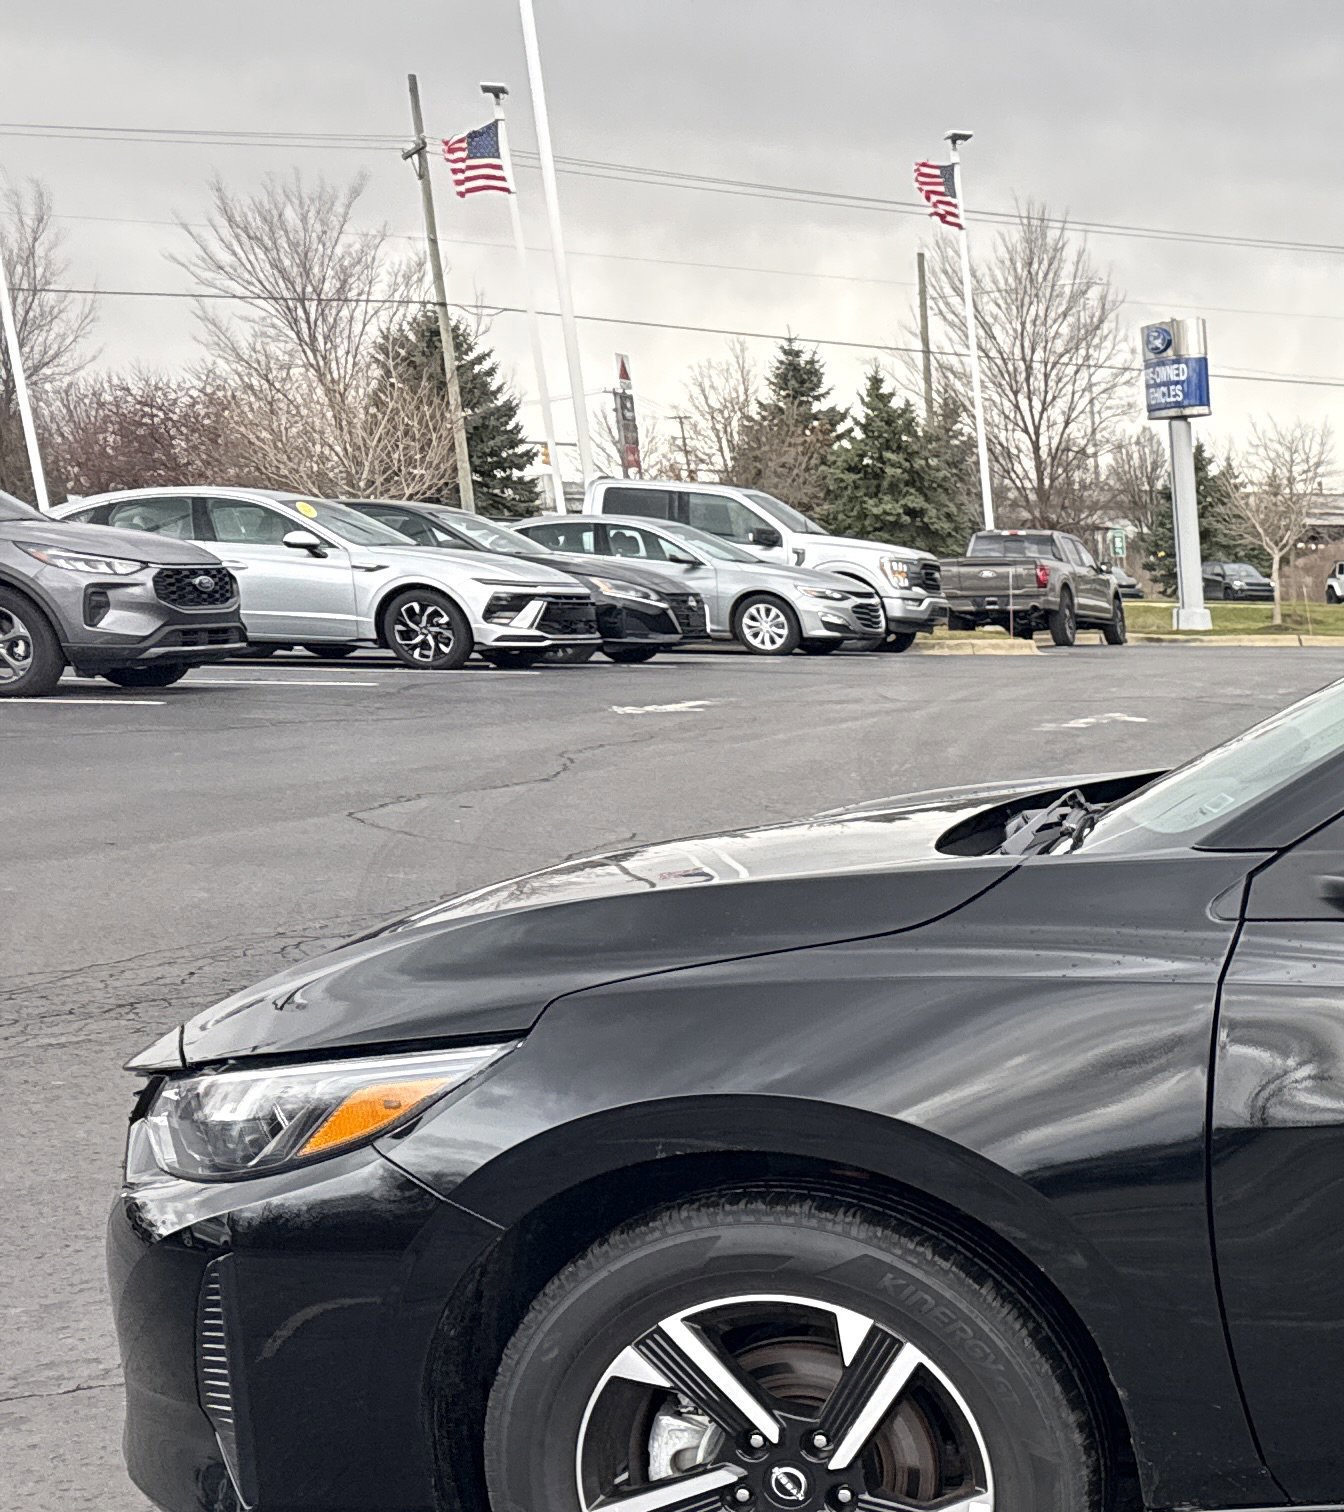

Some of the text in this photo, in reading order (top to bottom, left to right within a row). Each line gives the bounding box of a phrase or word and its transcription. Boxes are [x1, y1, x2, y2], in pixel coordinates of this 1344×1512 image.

[1145, 363, 1188, 385] E-OWNED
[1149, 384, 1184, 404] EHICLES
[876, 1272, 1005, 1371] KINERGY
